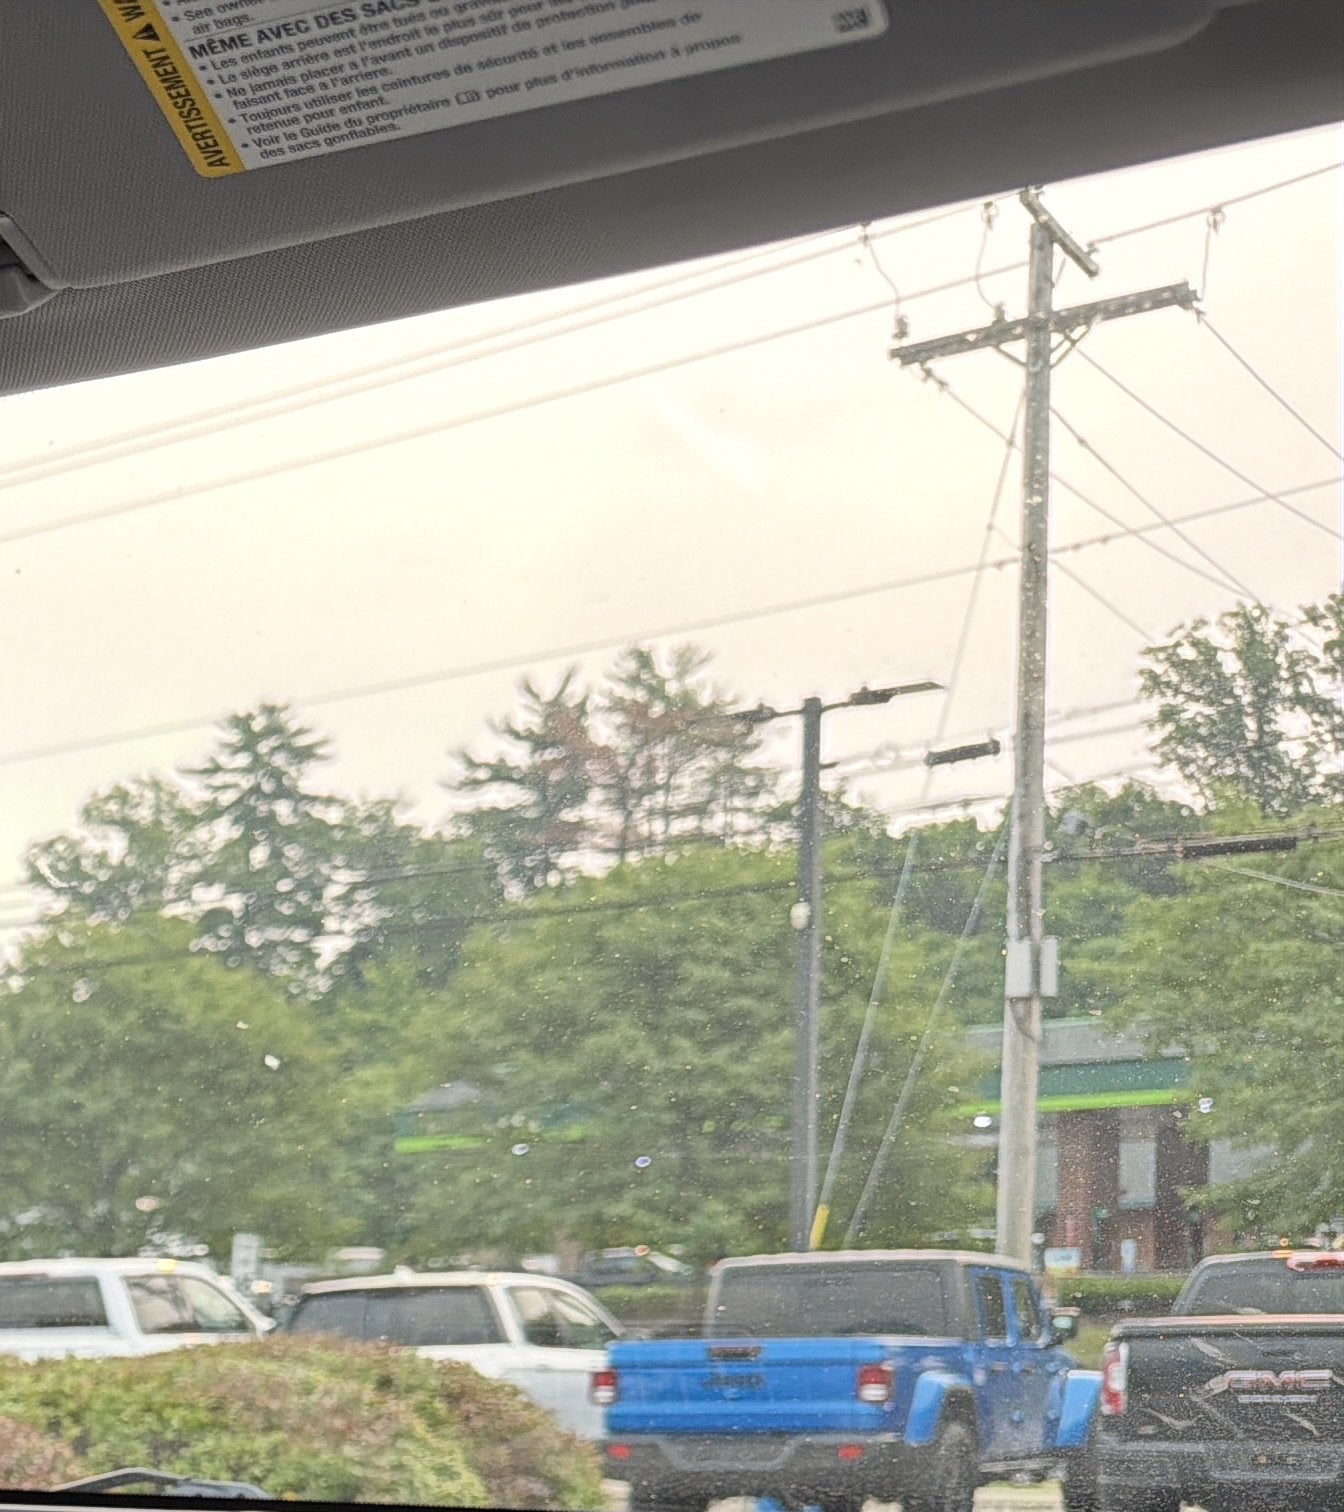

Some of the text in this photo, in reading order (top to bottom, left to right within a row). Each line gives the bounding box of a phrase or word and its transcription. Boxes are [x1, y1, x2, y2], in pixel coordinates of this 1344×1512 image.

[182, 8, 214, 23] See
[185, 31, 253, 59] MÊME
[252, 18, 312, 43] AVEC
[311, 6, 358, 30] DES
[189, 10, 255, 34] air bags.
[209, 55, 239, 71] Les
[238, 42, 295, 64] enfants
[294, 27, 358, 52] peuvent
[217, 71, 238, 84] Le
[238, 61, 279, 81] siège
[278, 49, 330, 70] arrière
[330, 43, 358, 58] est
[357, 27, 422, 52] l'endroit
[225, 85, 247, 99] Ne
[248, 73, 298, 94] jamais
[297, 62, 348, 83] placer
[359, 46, 413, 67] l'avant
[413, 43, 435, 55] un
[509, 18, 532, 32] de
[142, 47, 232, 169] AVERTISSEMENT
[231, 89, 283, 110] faisant
[282, 82, 316, 98] face
[239, 100, 303, 125] Toujours
[301, 89, 355, 110] utiliser
[354, 83, 379, 98] les
[378, 66, 452, 92] ceintures
[451, 61, 474, 76] de
[251, 133, 281, 149] Voir
[282, 129, 298, 142] le
[297, 119, 342, 138] Guide
[341, 115, 363, 129] du
[363, 95, 453, 126] propriétaire
[483, 80, 523, 99] pour
[245, 115, 301, 136] retenue
[301, 107, 337, 124] pour
[258, 145, 286, 160] des
[286, 137, 321, 154] sacs
[1224, 1369, 1334, 1391] GMC
